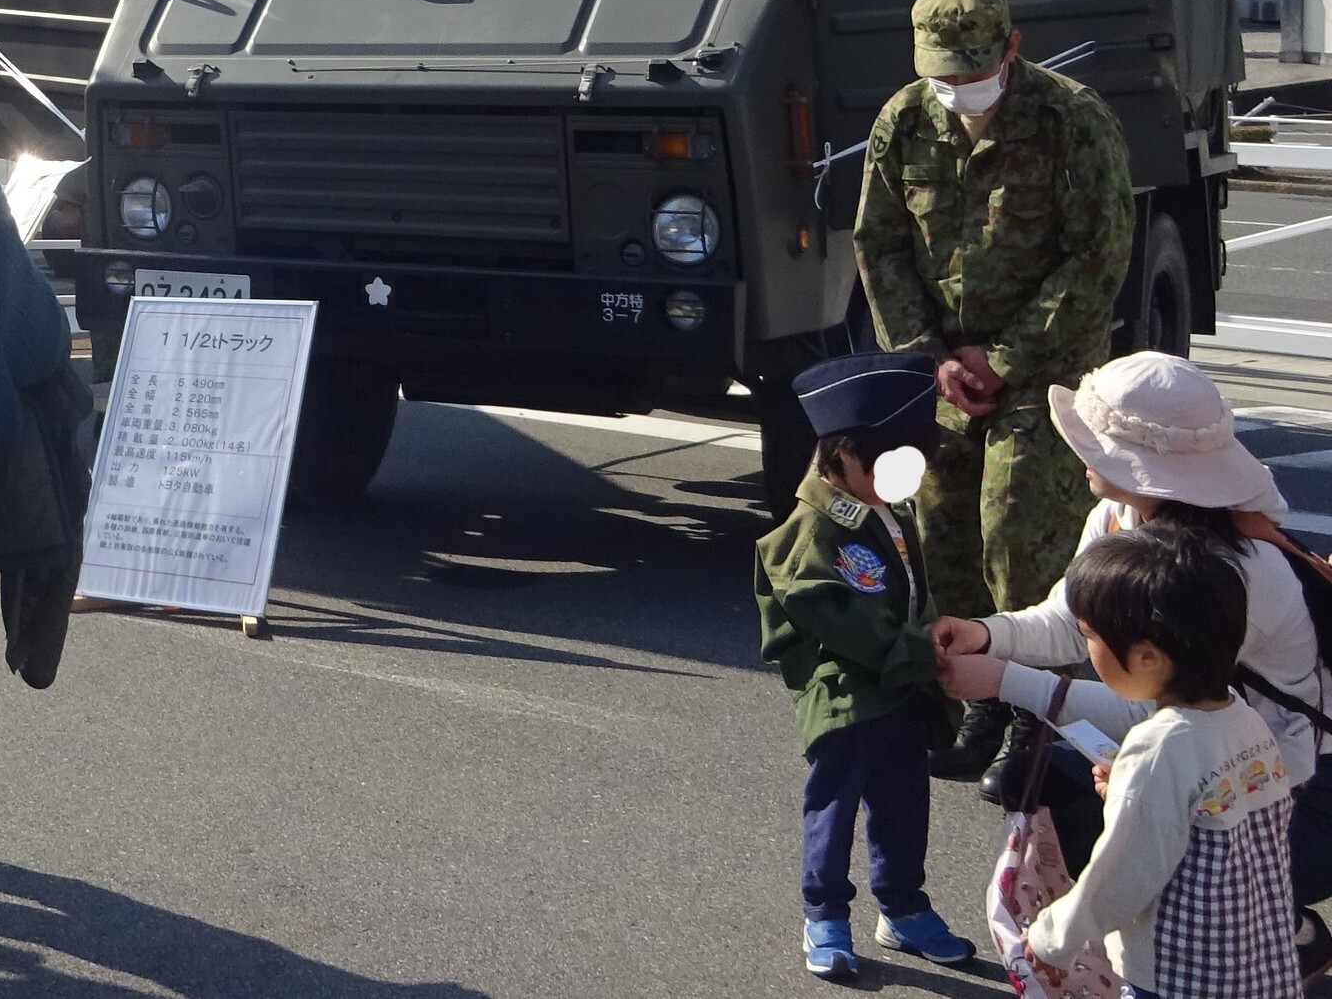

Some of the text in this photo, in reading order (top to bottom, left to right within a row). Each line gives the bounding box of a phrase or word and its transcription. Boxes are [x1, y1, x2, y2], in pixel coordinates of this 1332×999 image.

[601, 293, 644, 308] 中方特
[1197, 744, 1261, 792] HABURGER
